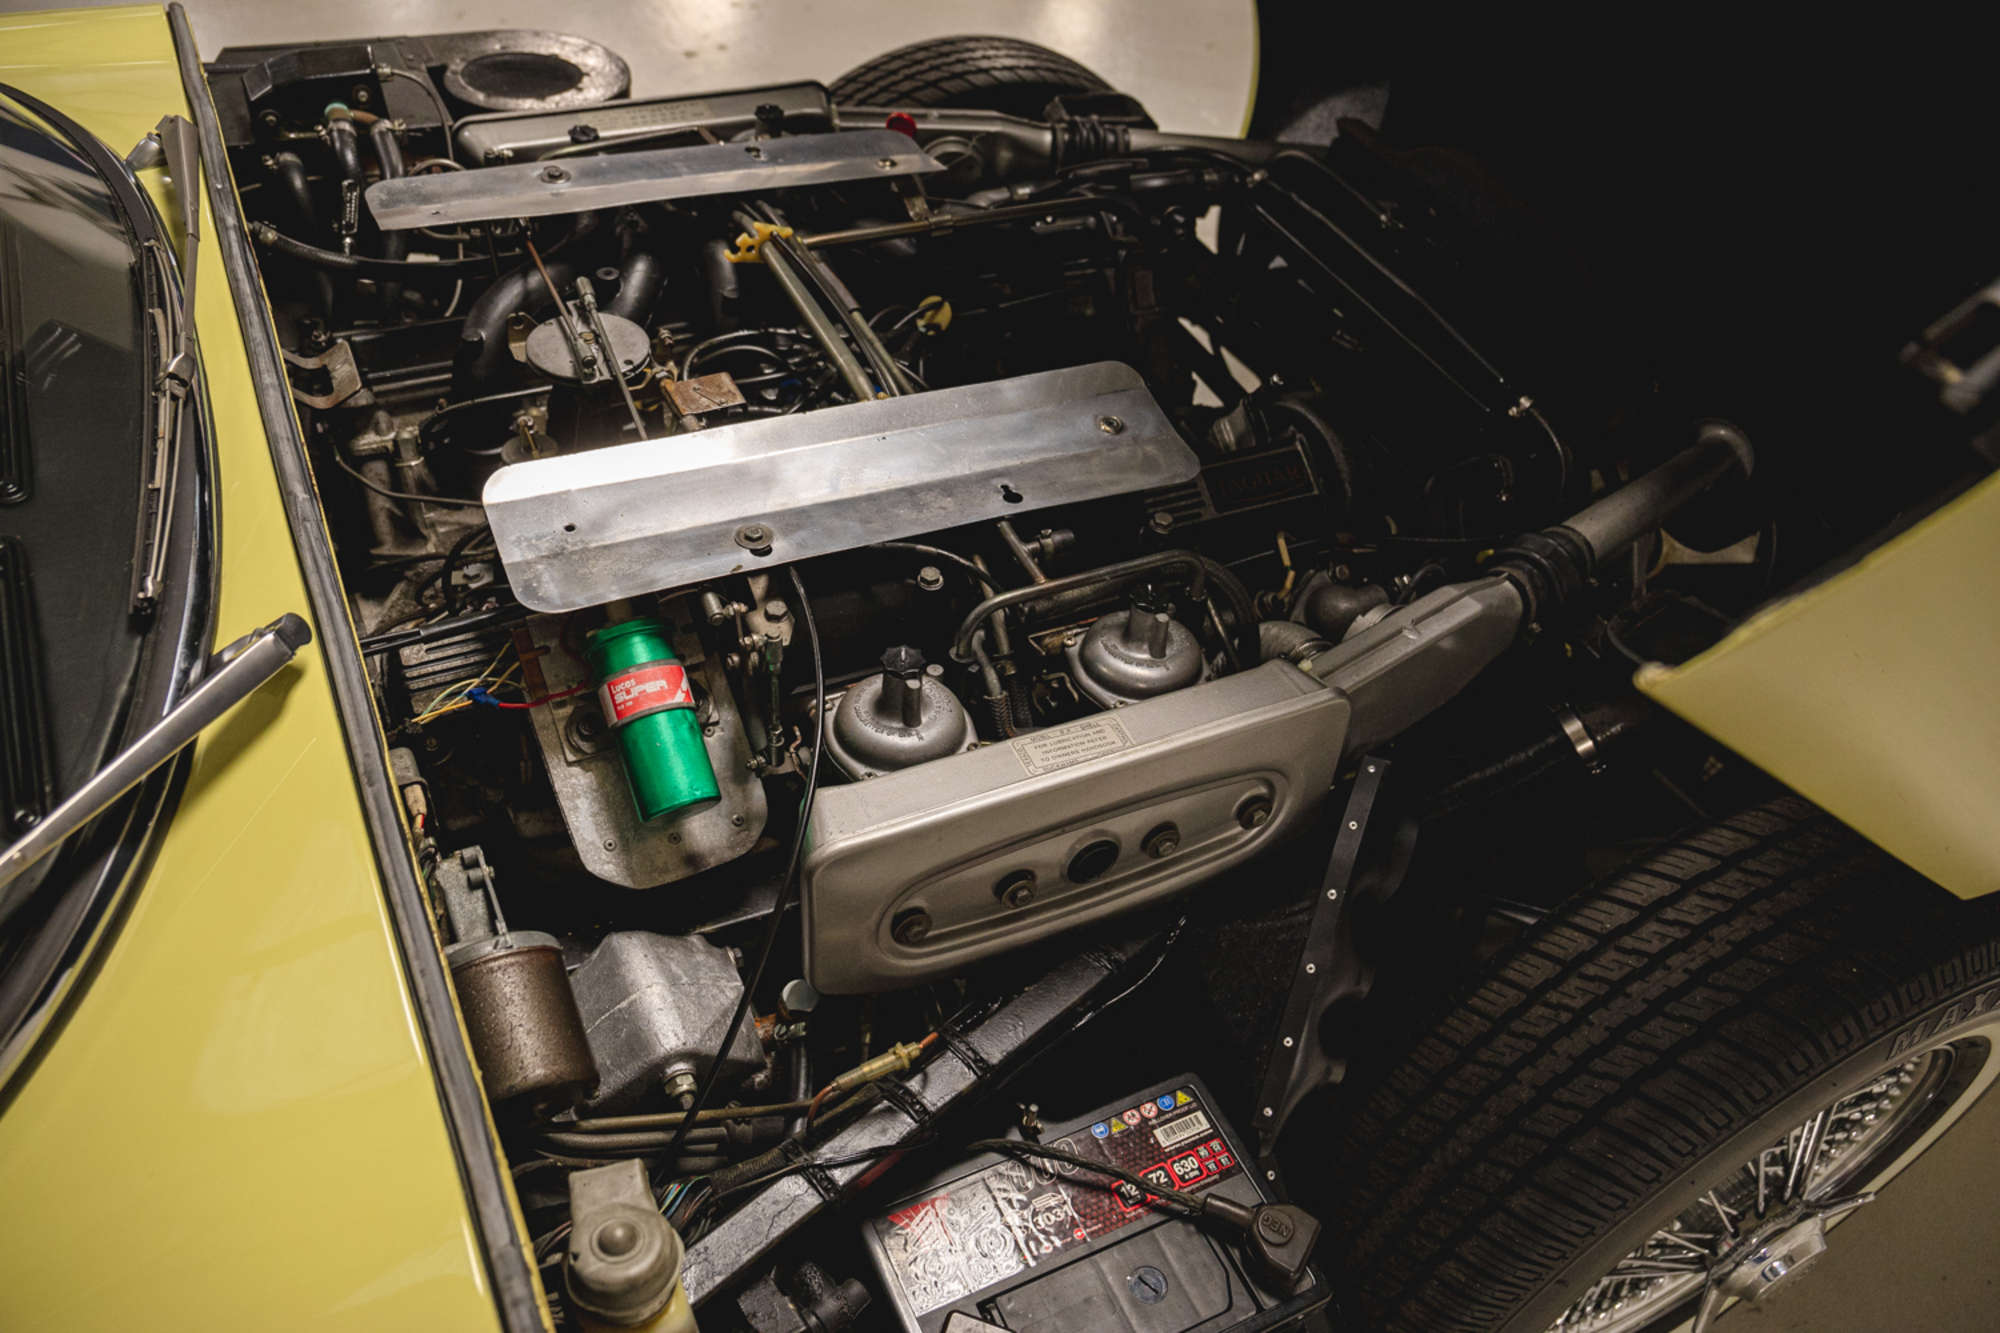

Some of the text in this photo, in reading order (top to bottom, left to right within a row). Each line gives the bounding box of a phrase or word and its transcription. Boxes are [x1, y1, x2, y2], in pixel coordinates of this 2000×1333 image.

[614, 680, 668, 703] SUPER
[1887, 989, 2000, 1061] MAX
[1173, 1156, 1198, 1175] 630
[1148, 1171, 1168, 1184] 72
[1120, 1183, 1140, 1197] 12
